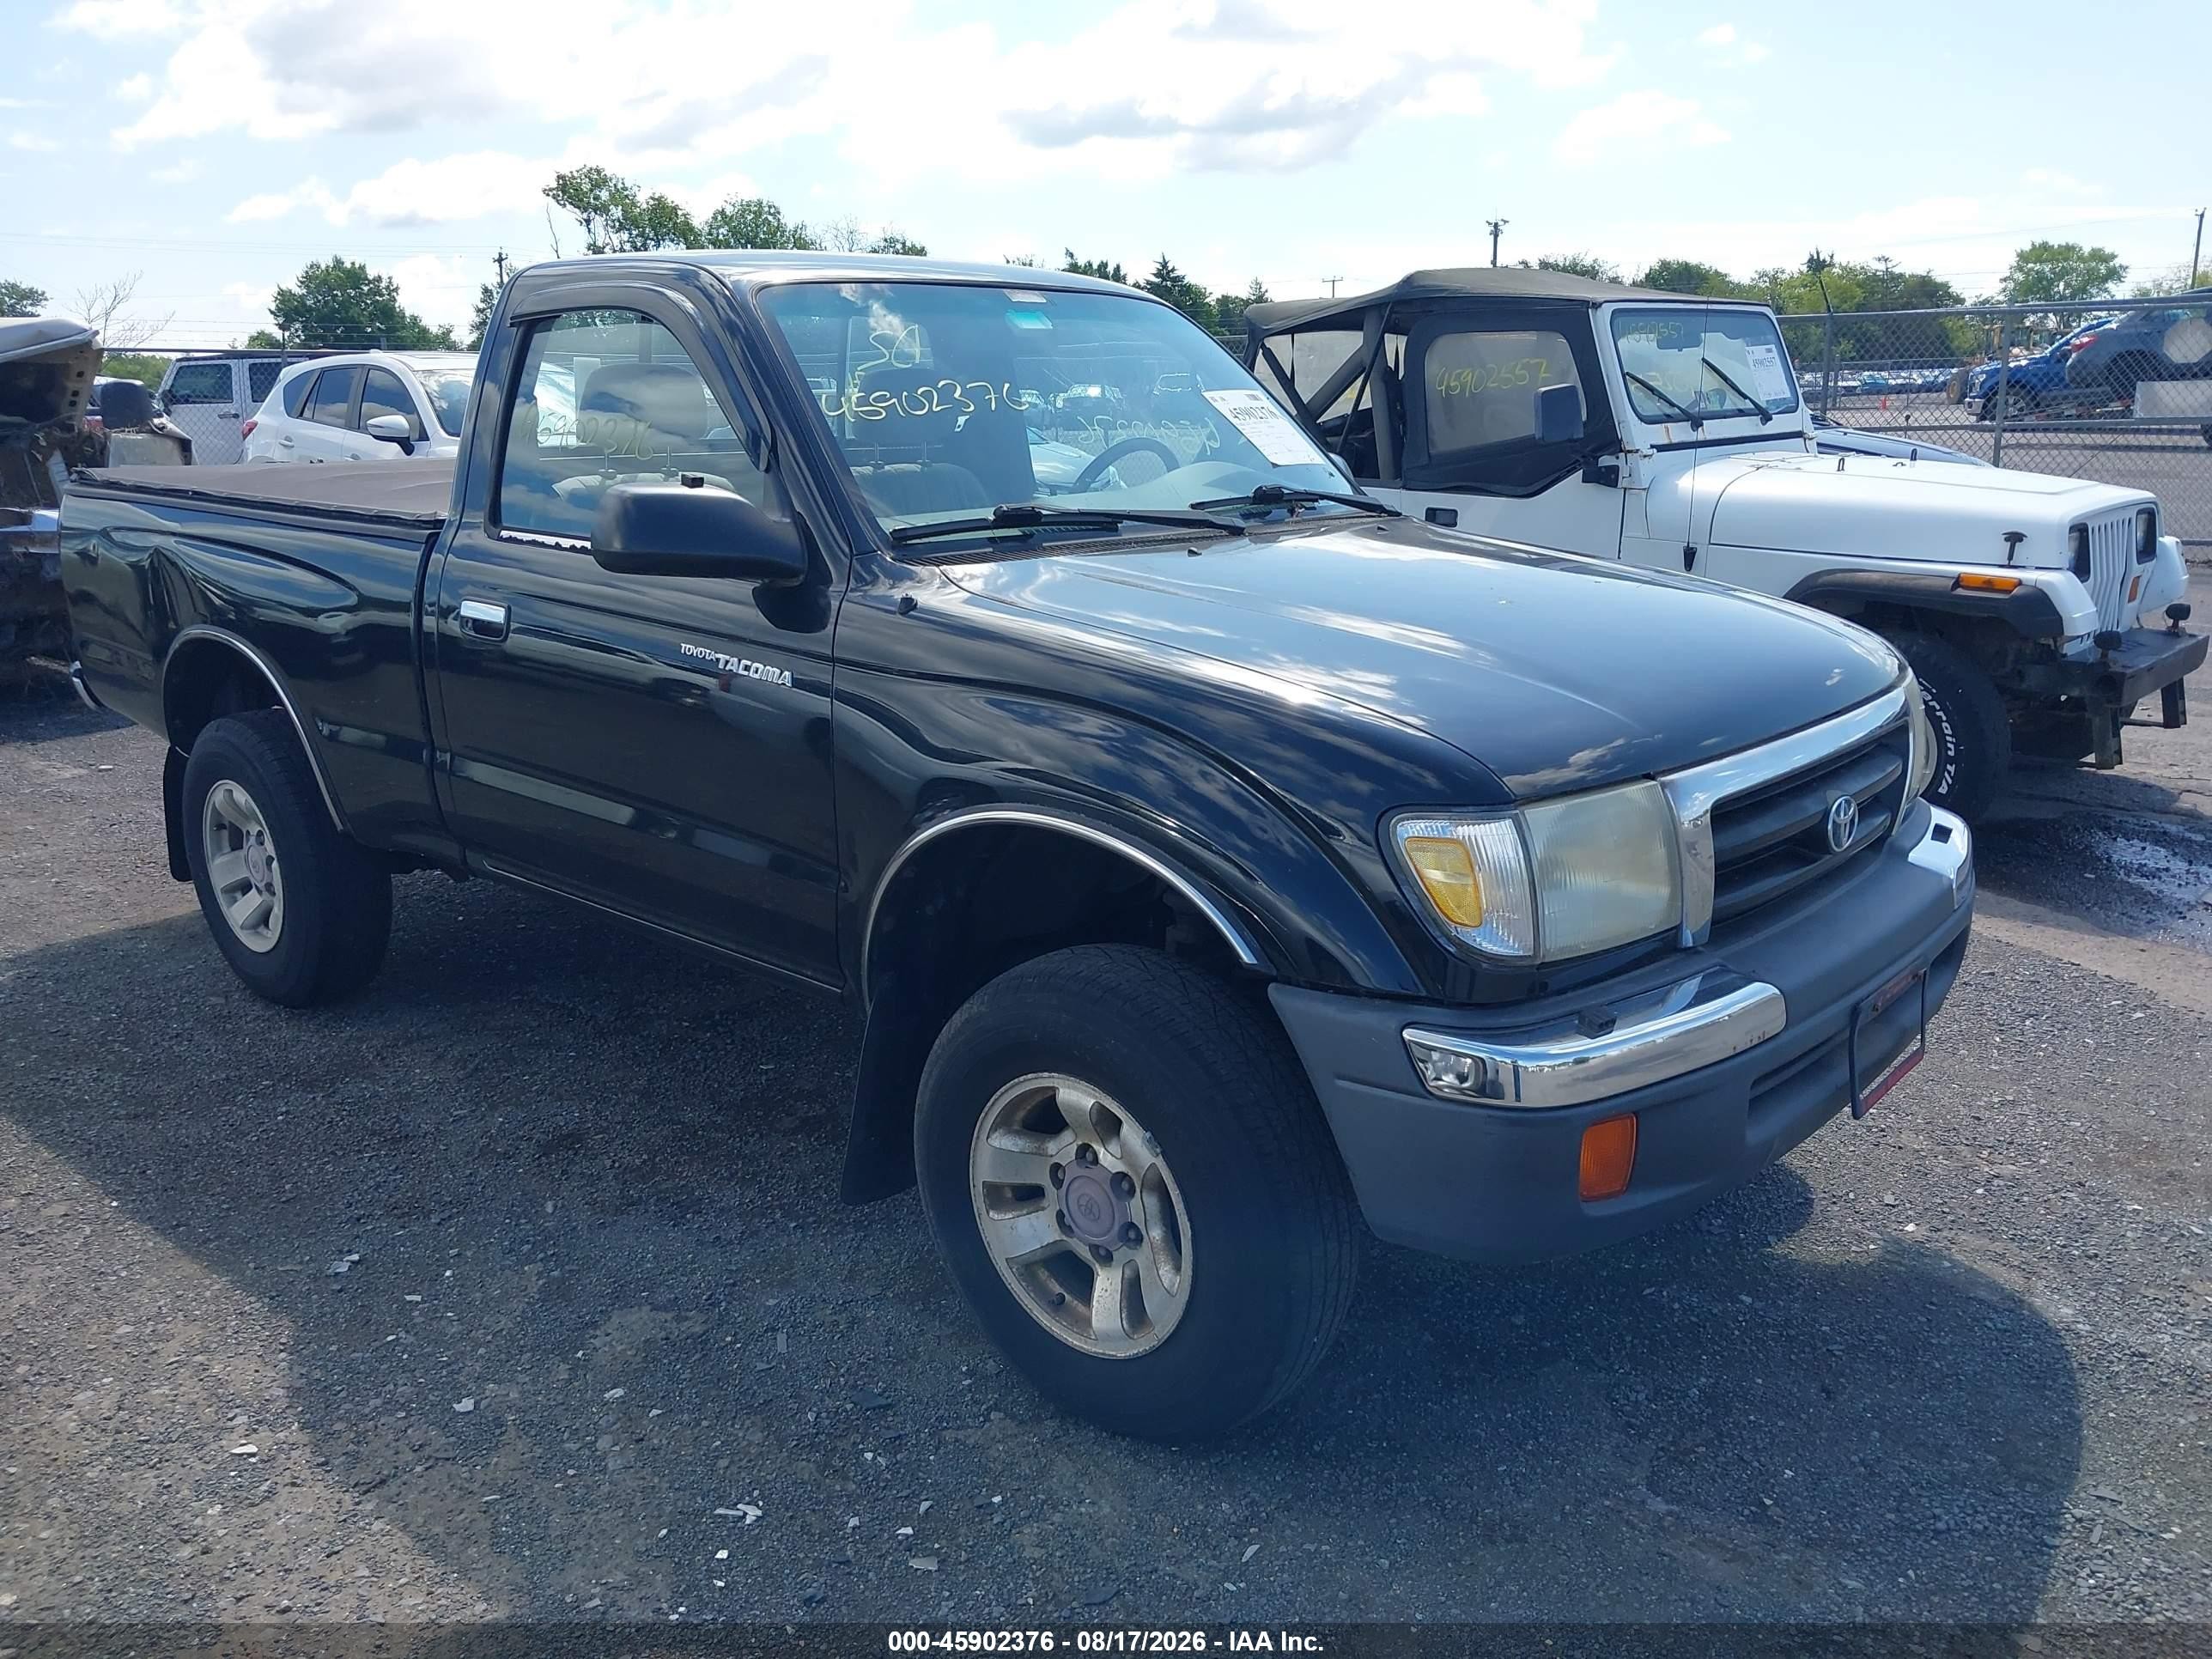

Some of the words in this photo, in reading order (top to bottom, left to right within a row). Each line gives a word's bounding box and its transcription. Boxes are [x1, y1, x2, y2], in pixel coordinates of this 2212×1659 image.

[822, 373, 1030, 422] 45902376
[1436, 357, 1552, 398] 45902557
[1228, 406, 1280, 421] 45902376
[680, 642, 716, 662] TOYOTA
[715, 653, 793, 688] TACOMA
[1936, 763, 1956, 794] T/A
